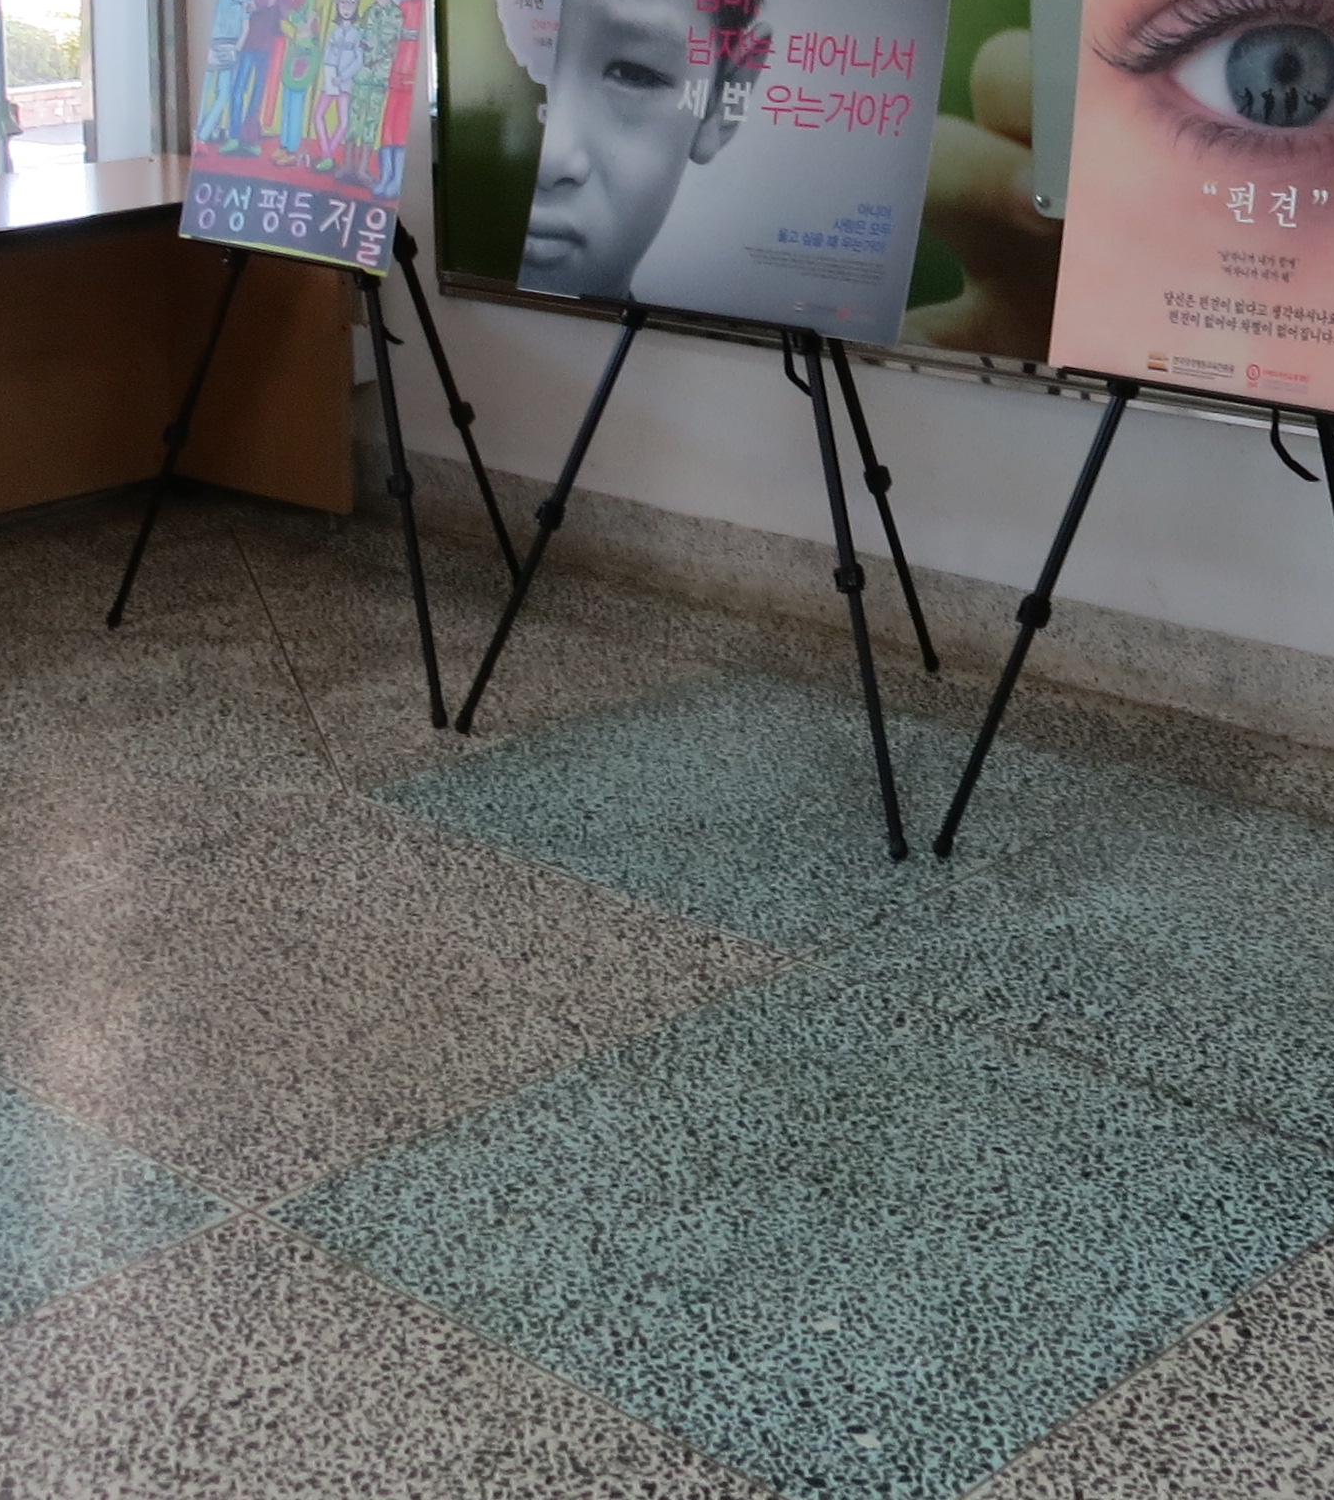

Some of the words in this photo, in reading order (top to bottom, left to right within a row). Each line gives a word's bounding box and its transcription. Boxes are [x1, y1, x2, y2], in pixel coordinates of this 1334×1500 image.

[688, 26, 776, 70] 남자는
[787, 31, 916, 80] 태어나서
[677, 78, 709, 120] 세
[722, 80, 752, 123] 번
[761, 84, 912, 137] 우는거야?
[1163, 290, 1197, 308] 당신은
[1199, 295, 1232, 312] 편견이
[1234, 301, 1269, 316] 없다고
[1168, 310, 1201, 327] 편견이
[1202, 314, 1237, 331] 없어야
